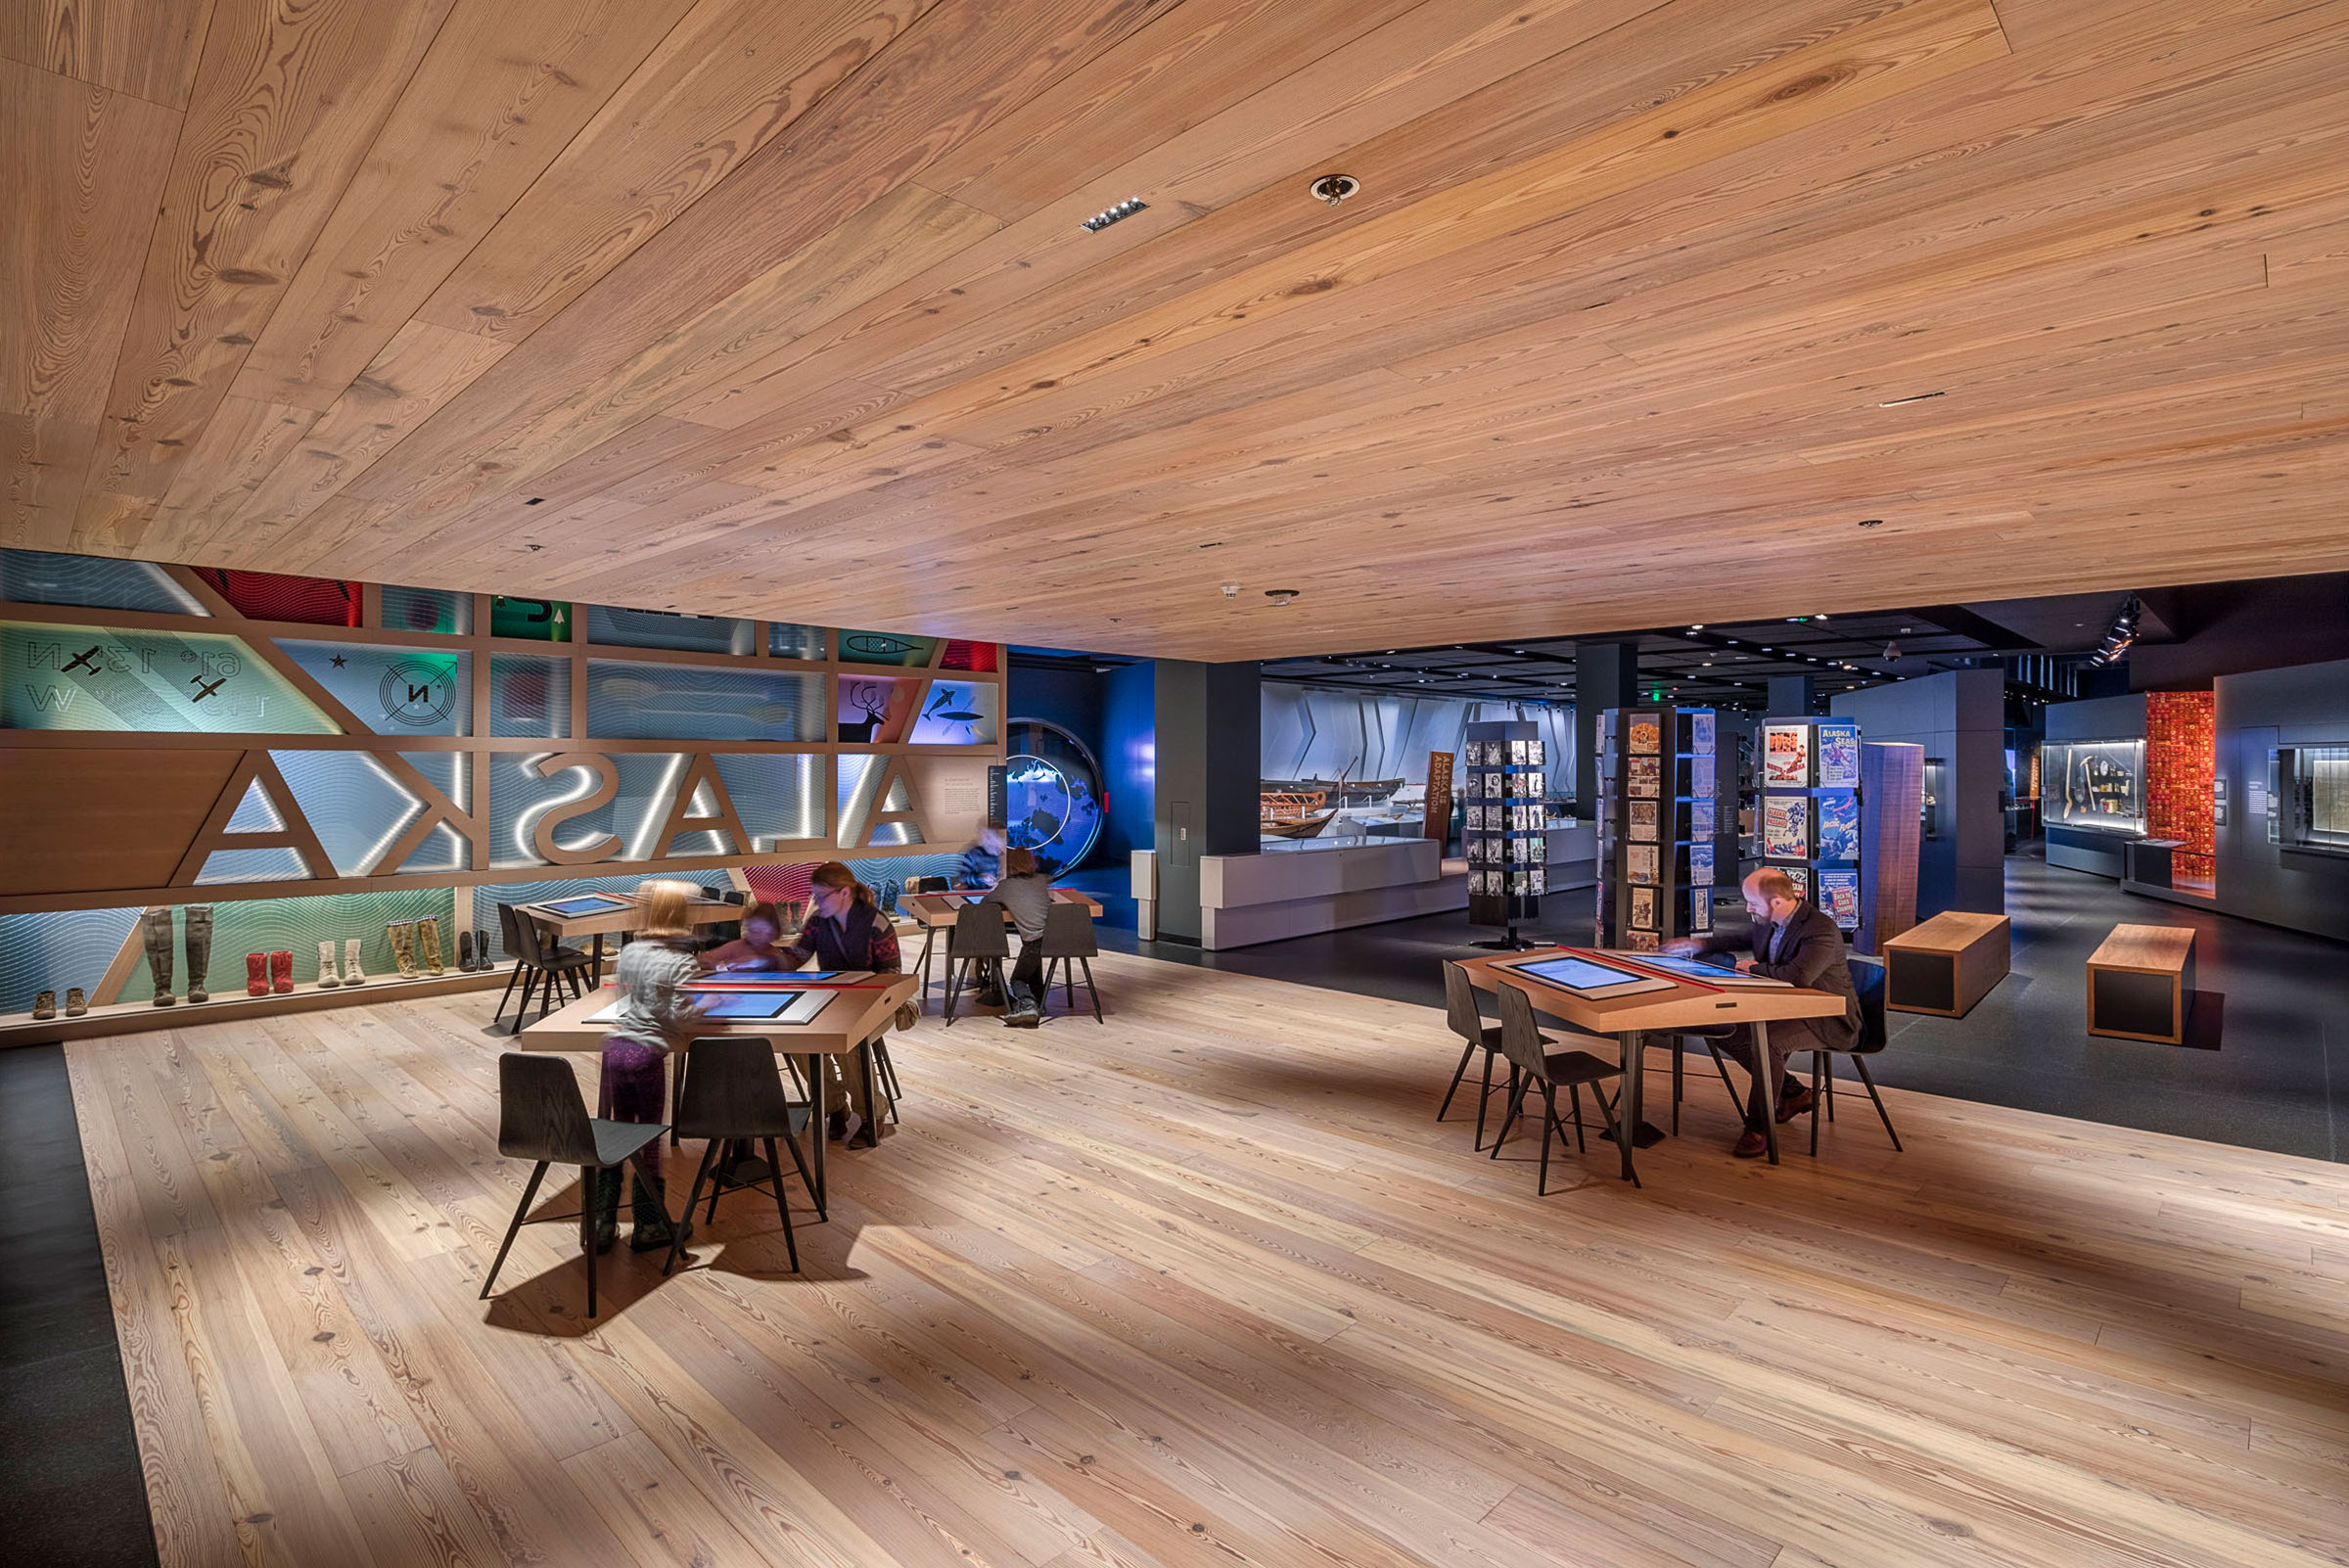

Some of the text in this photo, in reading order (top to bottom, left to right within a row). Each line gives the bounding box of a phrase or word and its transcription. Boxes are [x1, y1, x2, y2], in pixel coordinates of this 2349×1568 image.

[1822, 728, 1856, 746] ALASKA SEAS
[1431, 755, 1442, 813] ADAPTATION
[1441, 756, 1451, 793] ALASKA
